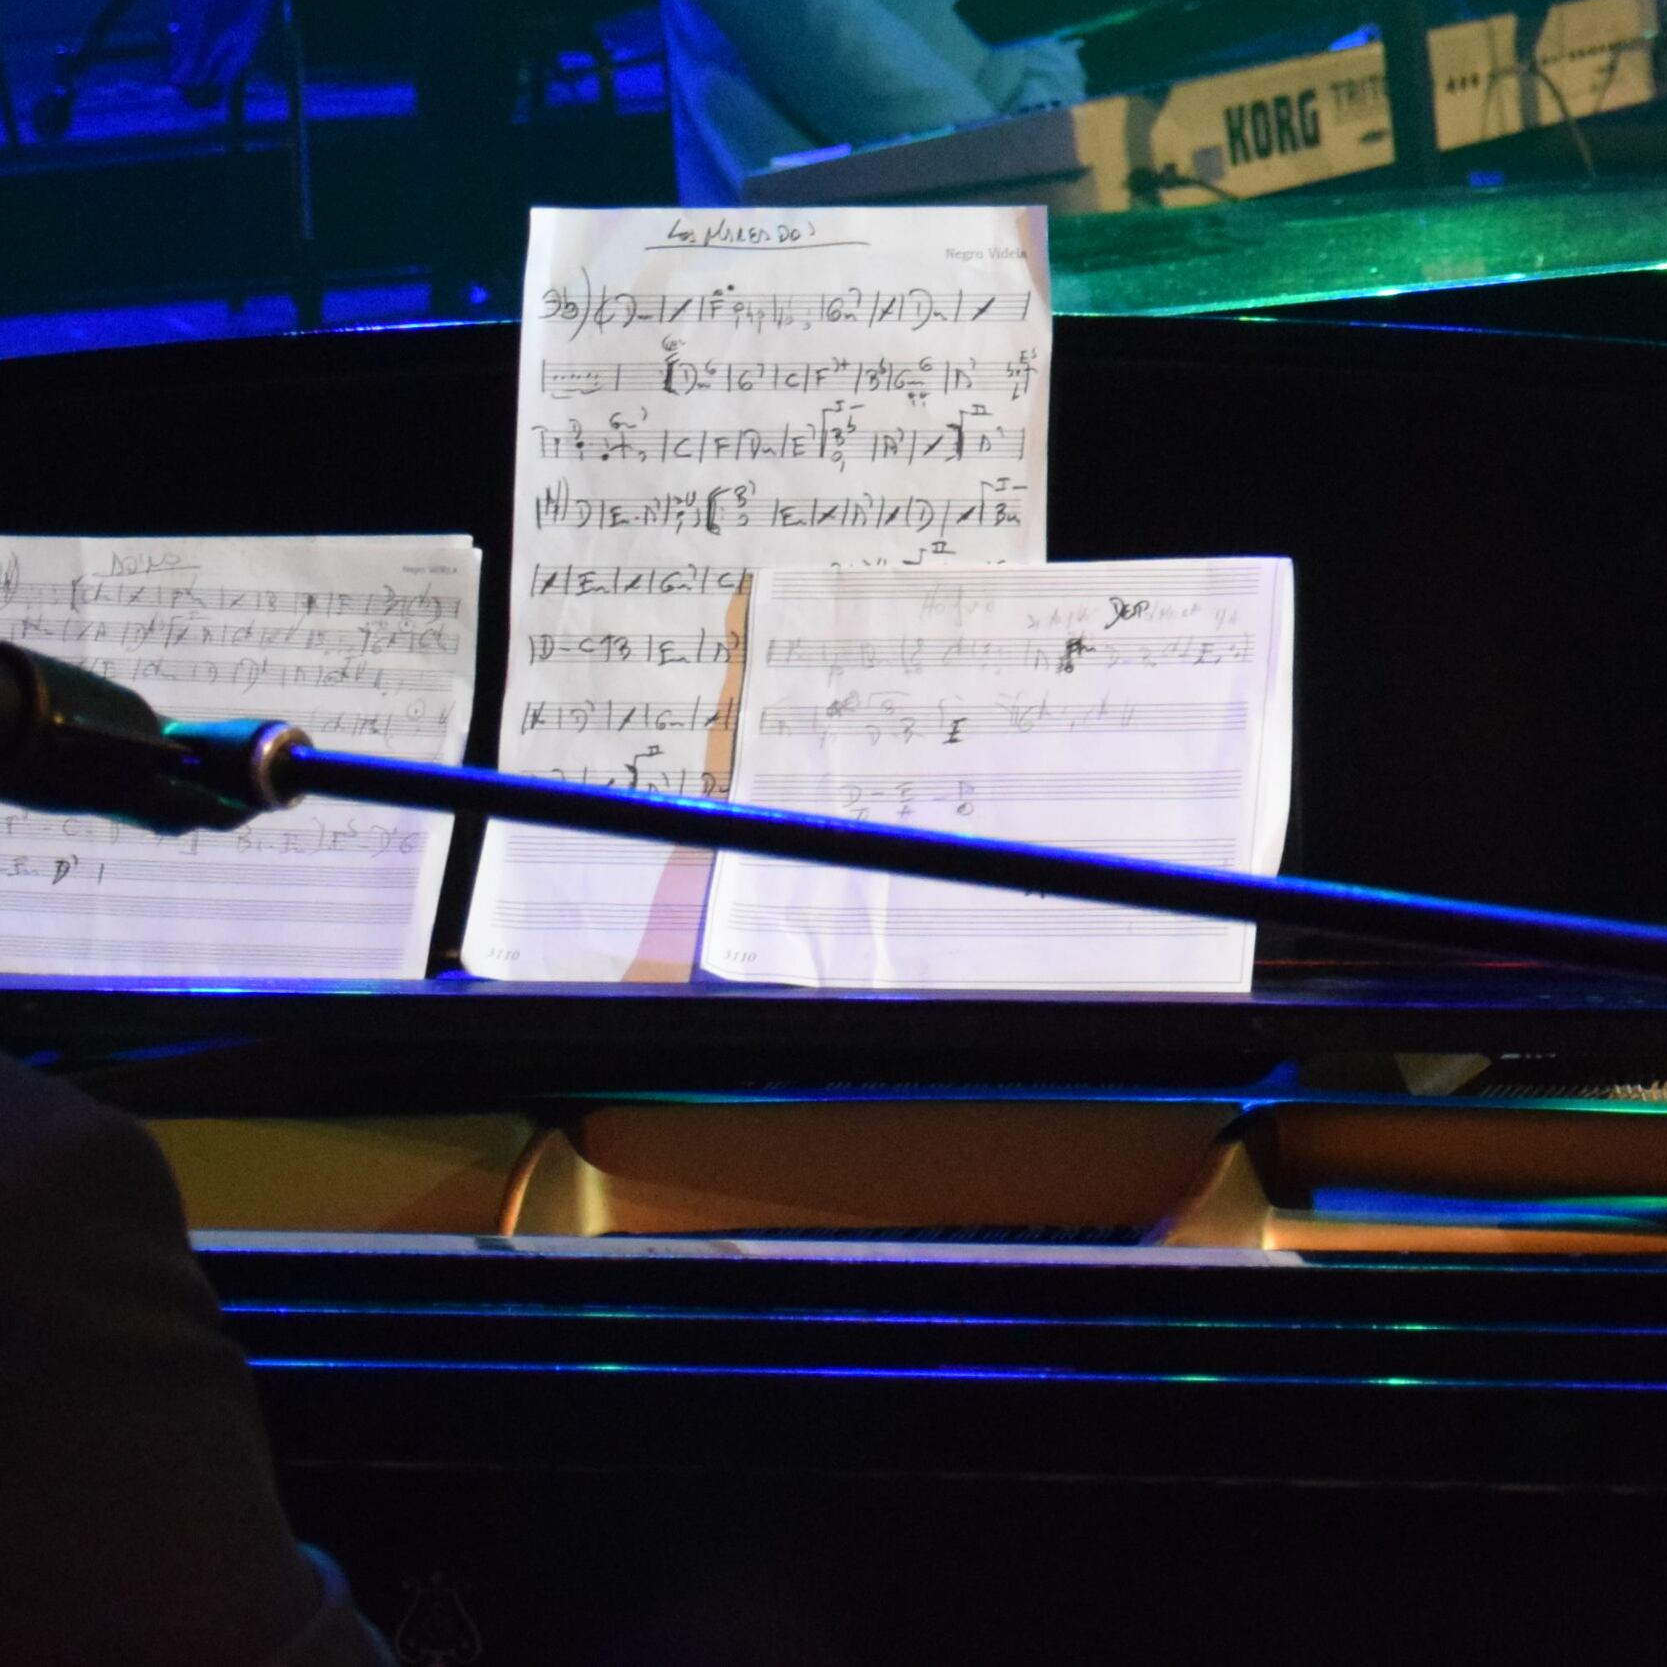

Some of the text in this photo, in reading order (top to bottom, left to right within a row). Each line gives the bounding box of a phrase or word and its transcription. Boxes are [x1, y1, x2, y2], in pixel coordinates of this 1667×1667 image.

[1223, 87, 1321, 167] KORG
[945, 248, 1029, 263] Negro Videla
